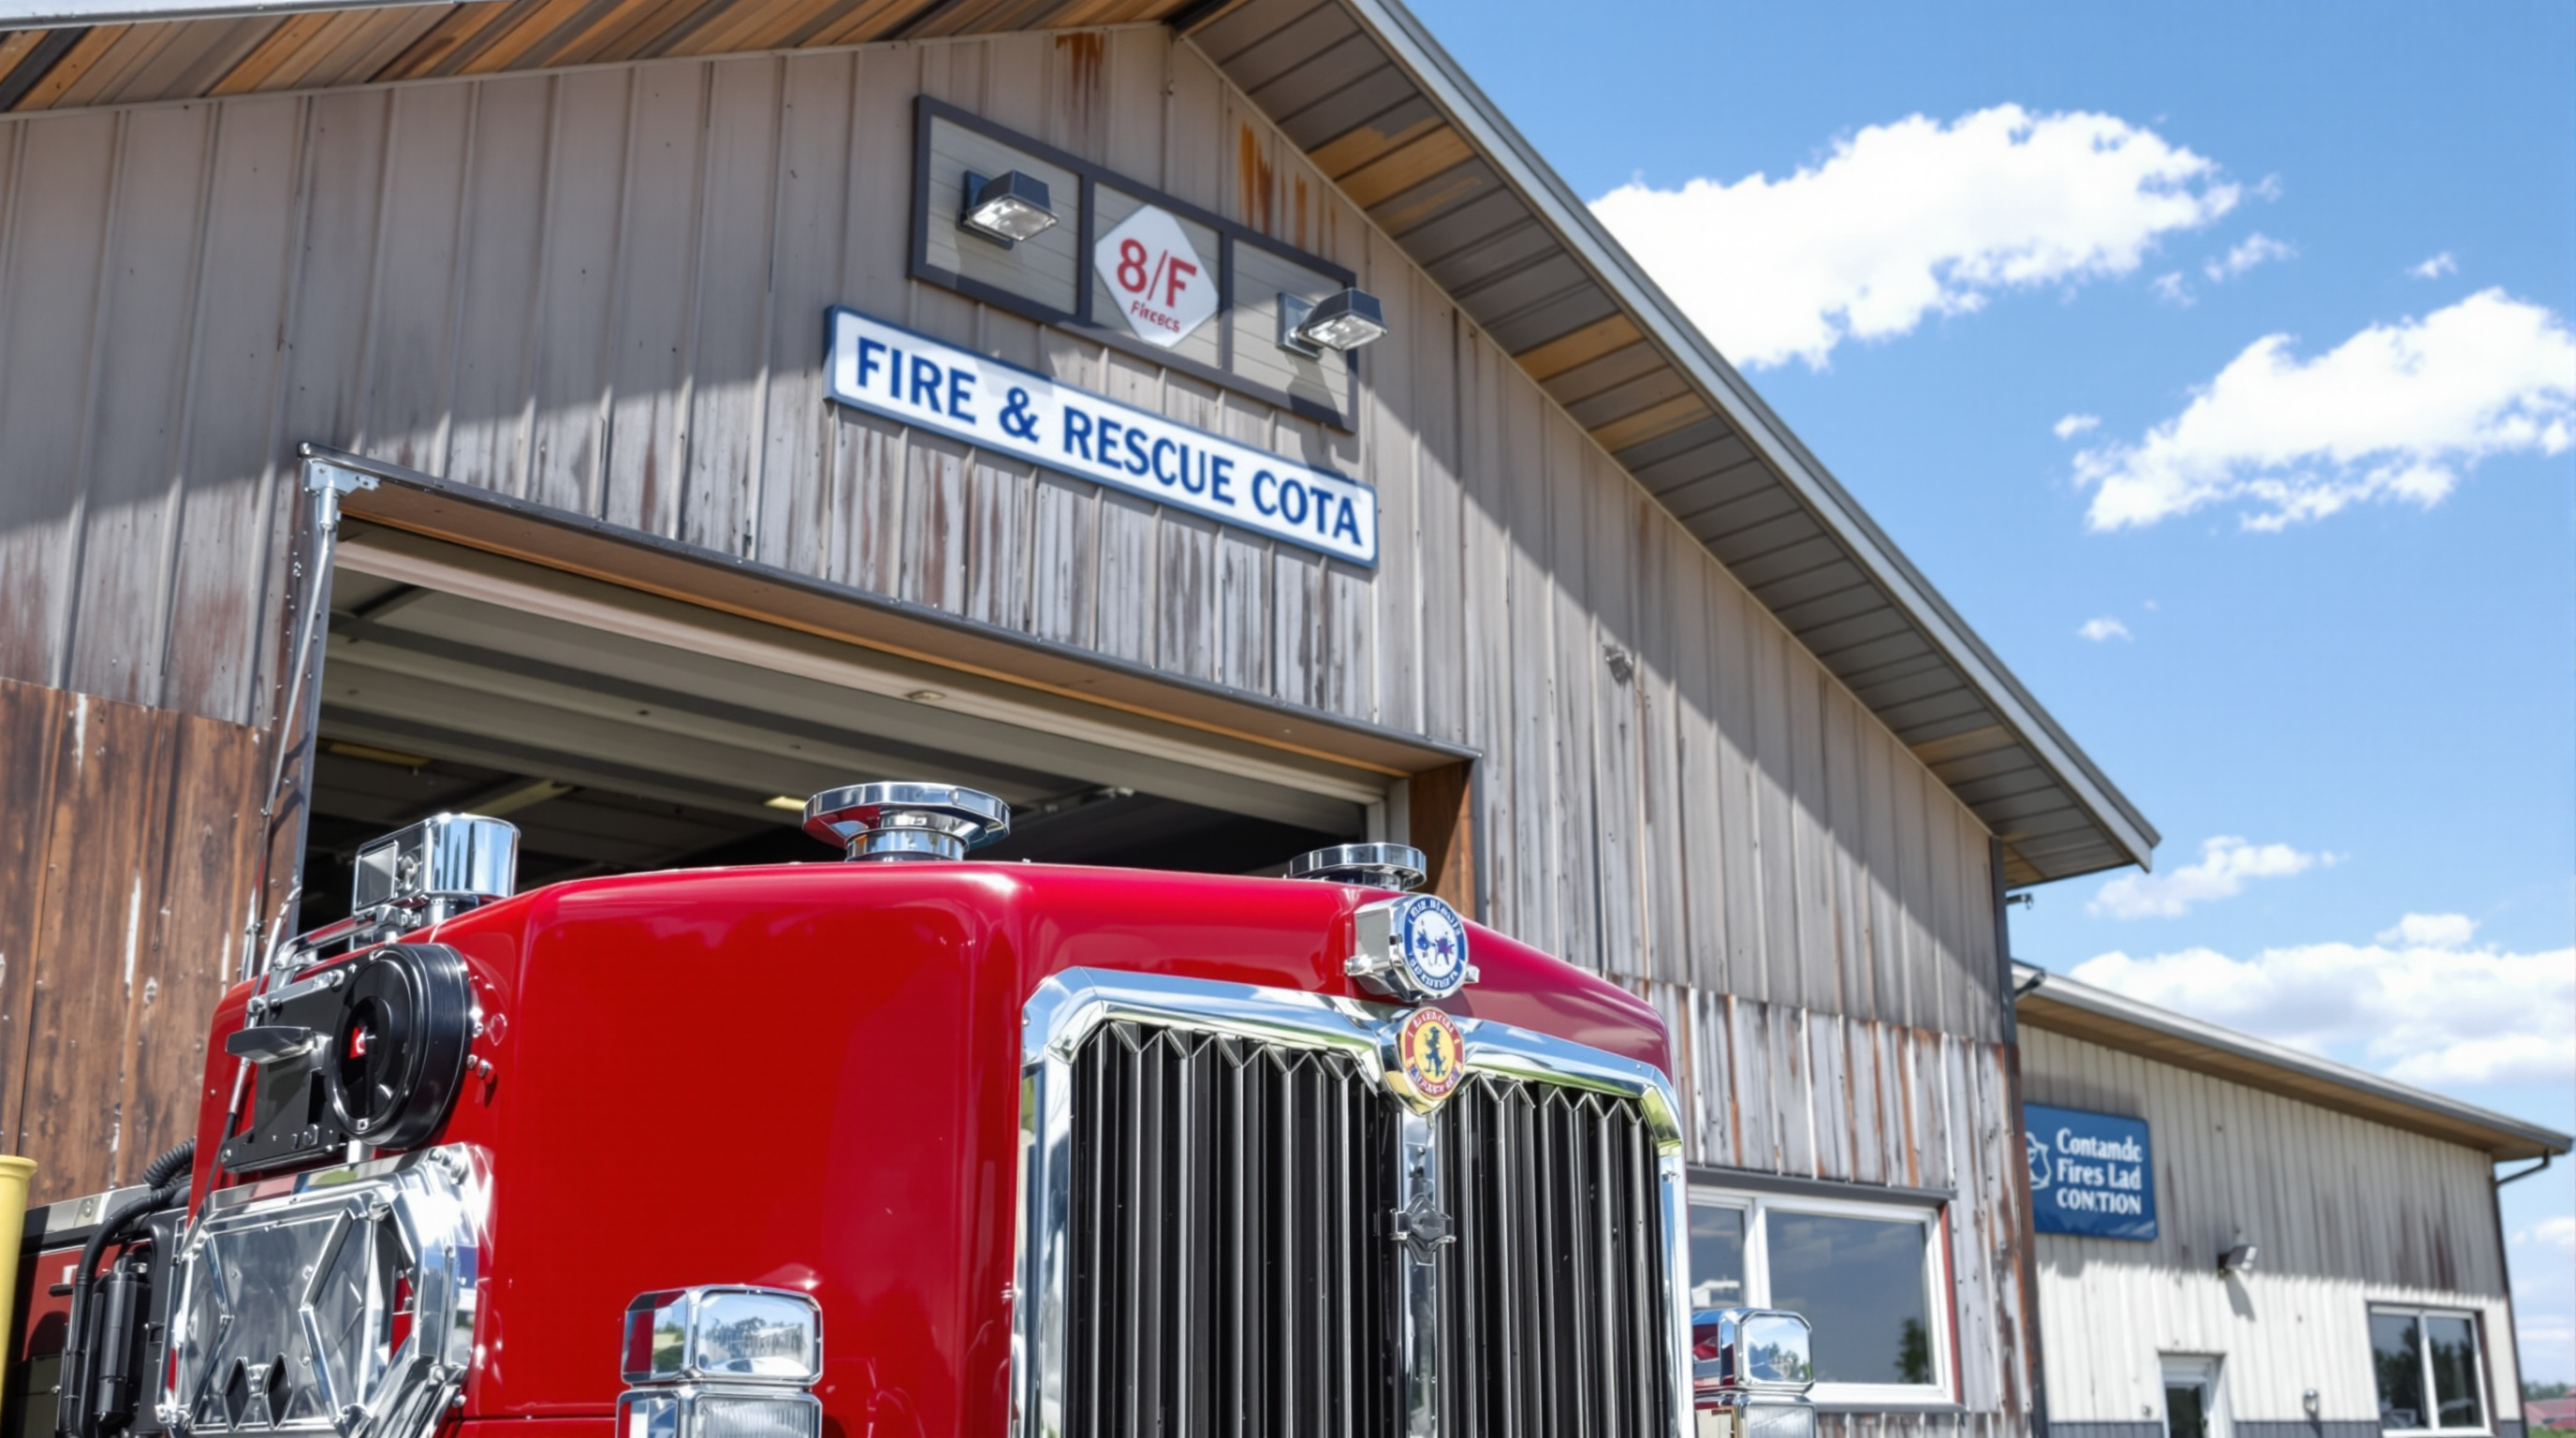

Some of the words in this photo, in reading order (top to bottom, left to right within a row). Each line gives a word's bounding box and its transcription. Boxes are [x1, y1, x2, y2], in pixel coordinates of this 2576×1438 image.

[1117, 239, 1197, 308] 8/F
[856, 336, 976, 424] FIRE
[999, 387, 1040, 443] &
[1063, 405, 1236, 506] RESCUE
[1251, 469, 1363, 547] COTA
[2056, 1158, 2104, 1187] Fires
[2108, 1162, 2142, 1190] Lad
